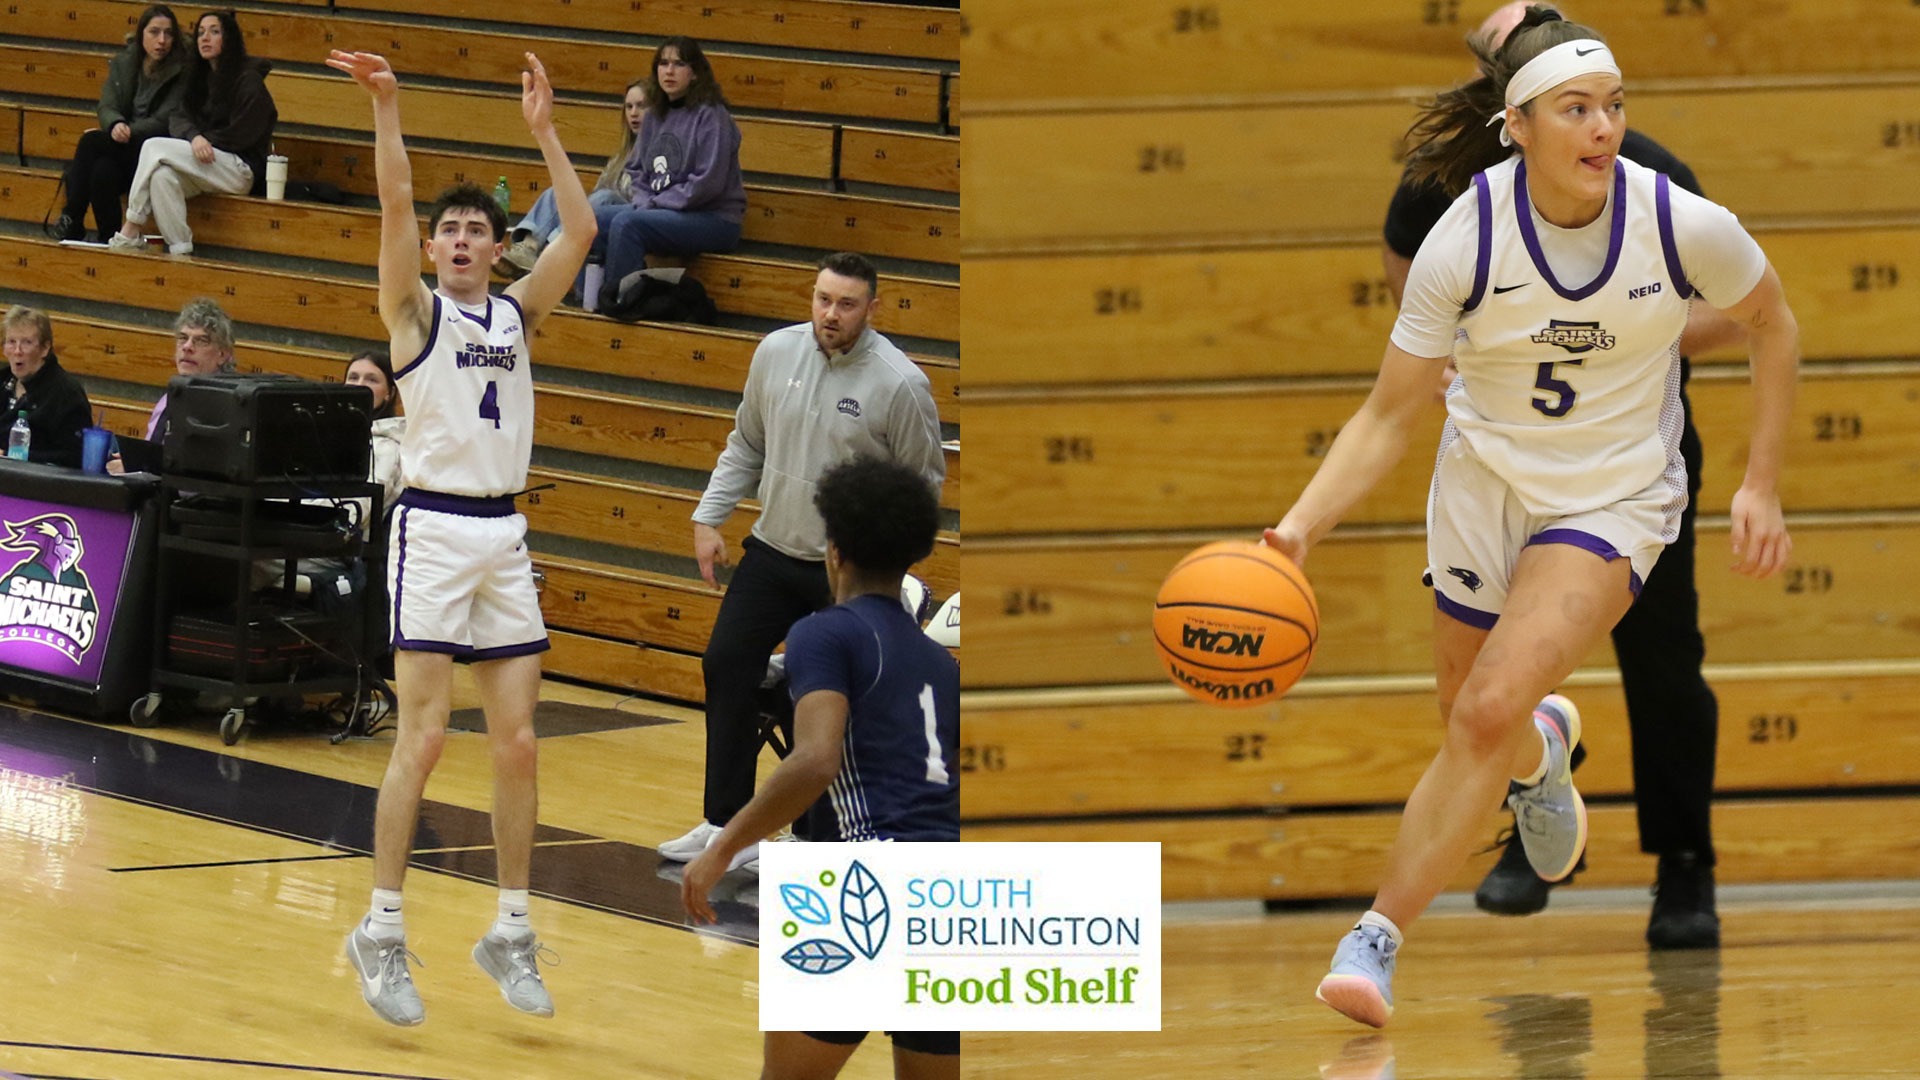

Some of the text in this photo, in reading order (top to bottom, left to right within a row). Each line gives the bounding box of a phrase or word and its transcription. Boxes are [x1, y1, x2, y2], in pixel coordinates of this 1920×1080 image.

[928, 225, 942, 236] 26
[1852, 264, 1899, 291] 29
[1093, 287, 1143, 315] 26
[465, 342, 514, 355] SAINT
[610, 338, 622, 349] 27
[692, 350, 706, 361] 26
[1531, 358, 1584, 419] 5
[479, 381, 501, 430] 4
[570, 414, 583, 426] 26
[652, 426, 666, 438] 25
[1813, 414, 1863, 442] 29
[1044, 435, 1095, 463] 26
[9, 575, 89, 609] SAINT
[1785, 566, 1834, 594] 29
[574, 590, 586, 602] 23
[1004, 588, 1053, 616] 26
[667, 607, 680, 620] 22
[1182, 623, 1265, 657] NCAA
[919, 683, 949, 785] 1
[1748, 715, 1797, 744] 29
[1225, 734, 1267, 762] 27
